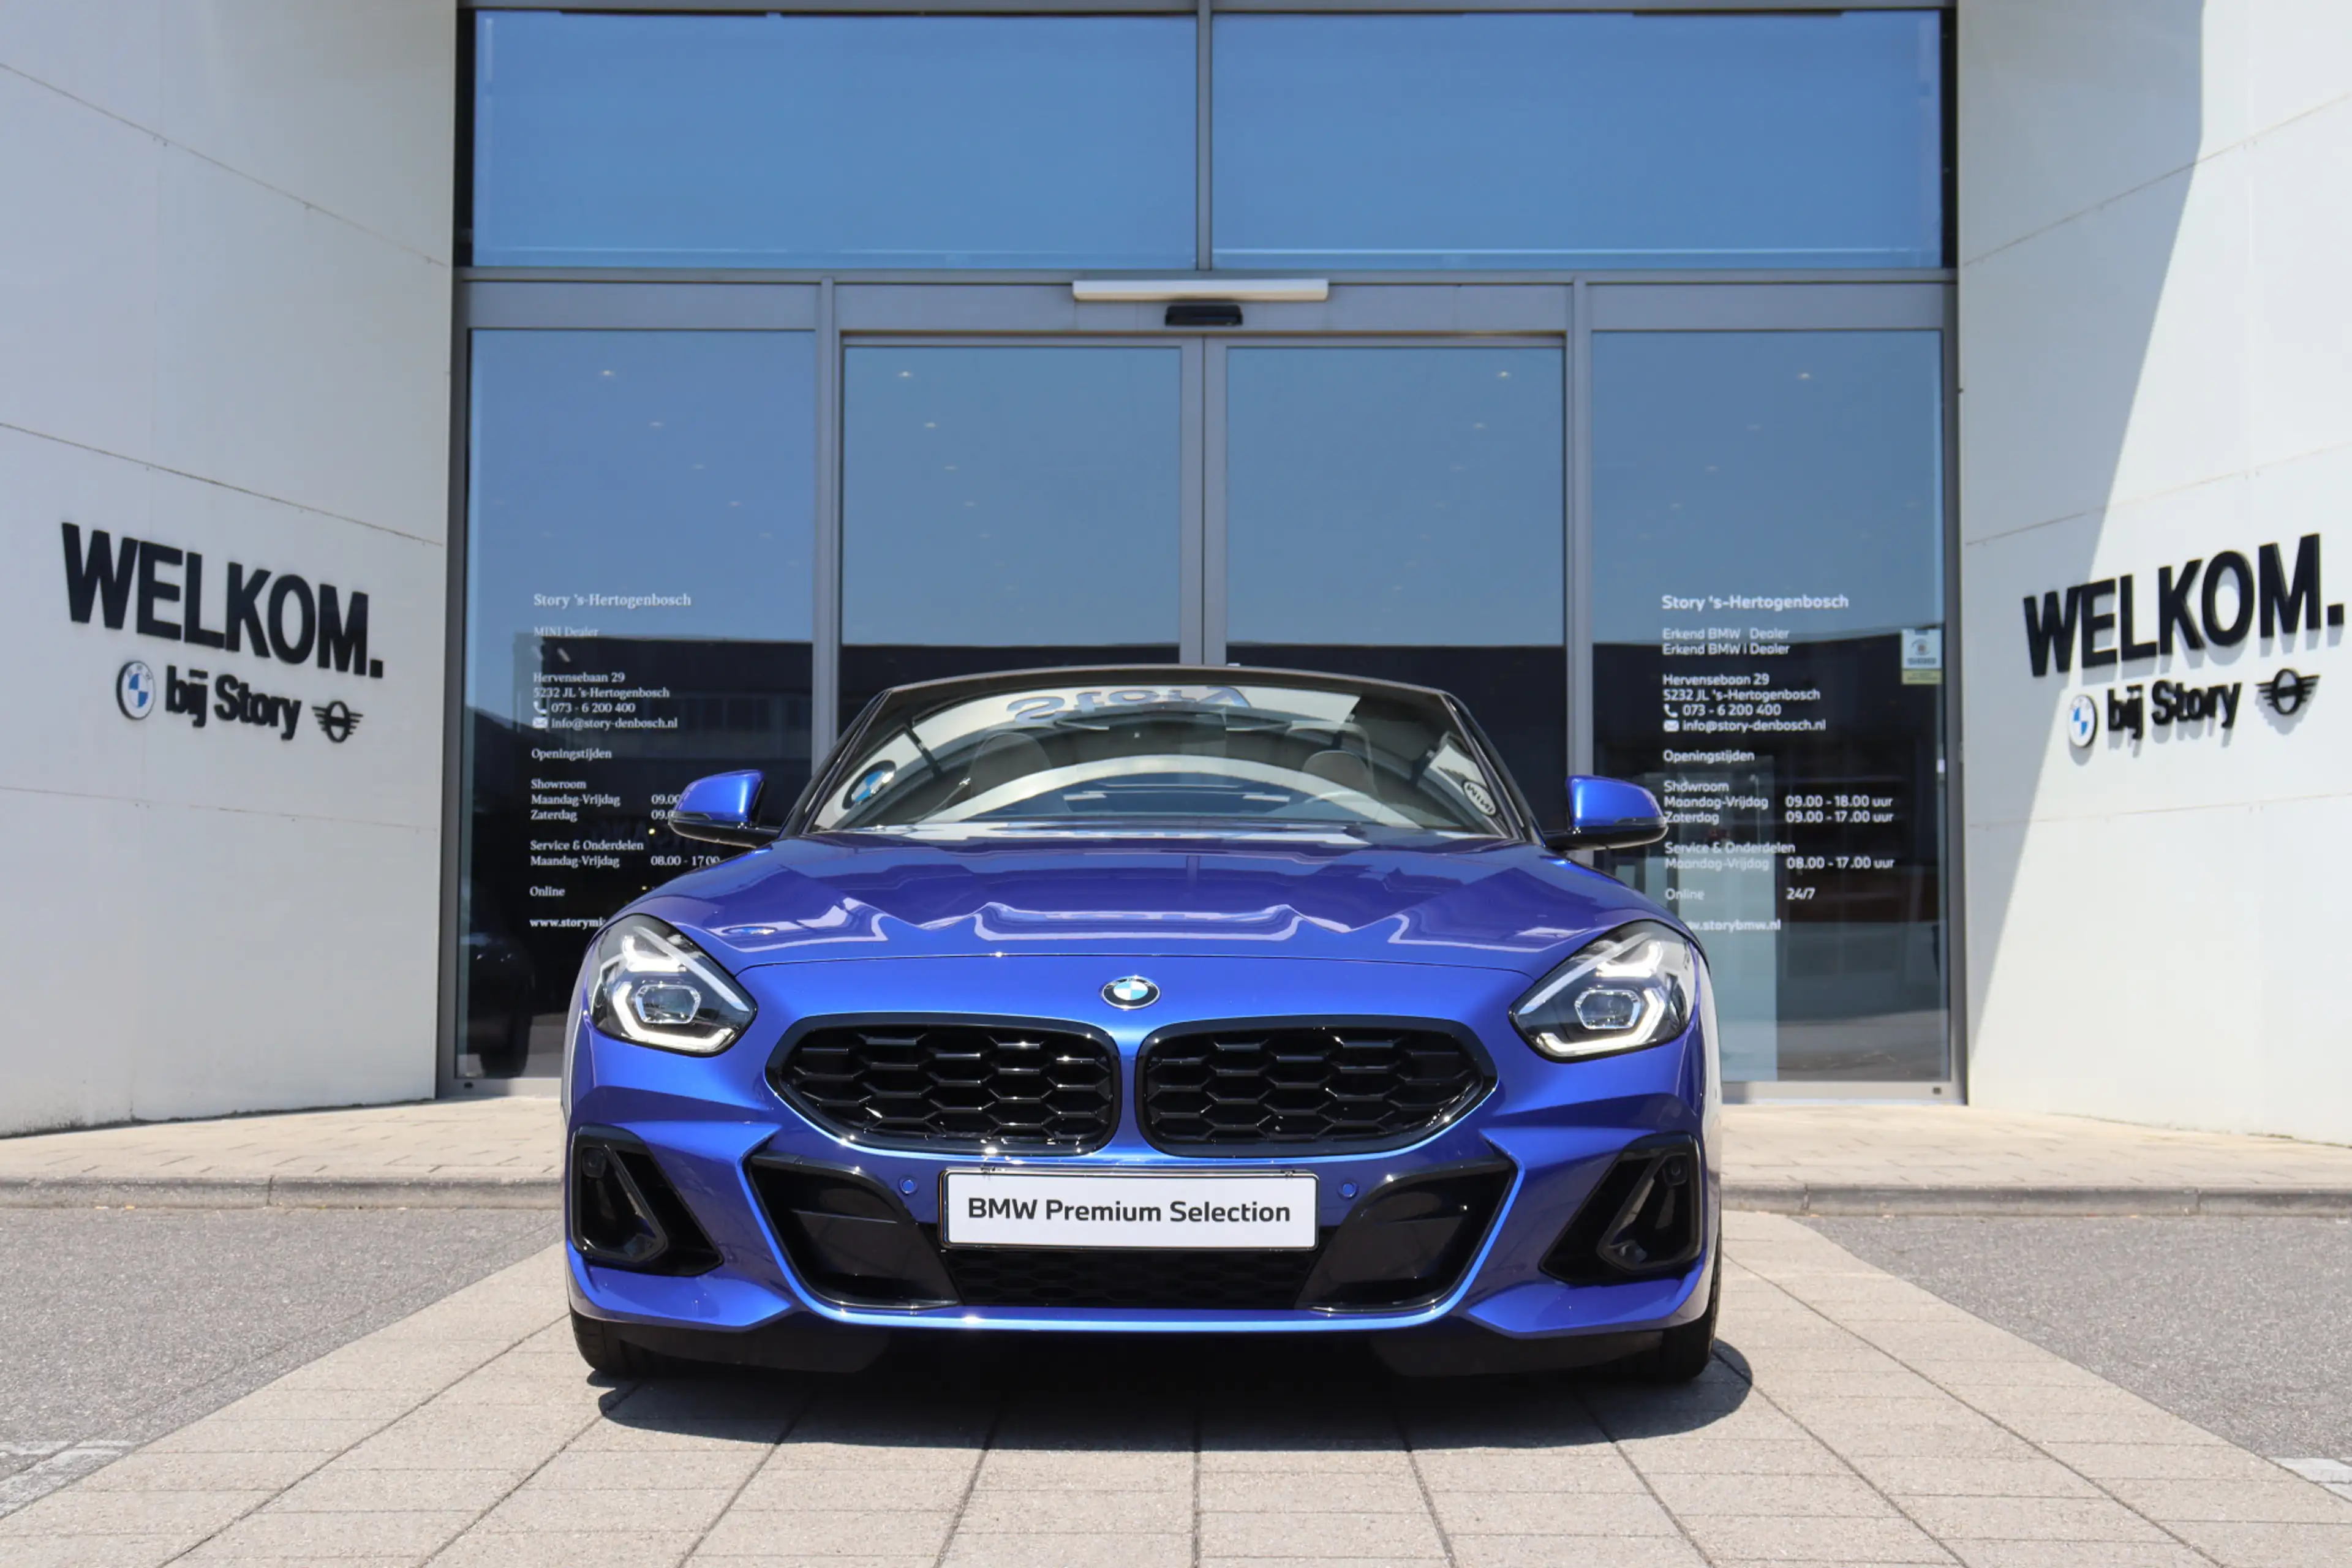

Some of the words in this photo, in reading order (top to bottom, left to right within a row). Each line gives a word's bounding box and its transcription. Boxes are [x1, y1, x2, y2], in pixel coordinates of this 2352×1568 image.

[61, 522, 383, 678] WELKOM.
[533, 594, 570, 609] Story
[574, 594, 692, 609] 's-Hertogenbosch
[1662, 595, 1705, 611] Story
[1709, 595, 1849, 611] 's-Hertogenbosch
[2023, 533, 2344, 677] WELKOM.
[533, 627, 562, 636] MINI
[564, 627, 599, 637] Dealer
[1662, 627, 1705, 639] Erkend
[1708, 628, 1741, 639] BMW
[1749, 627, 1790, 639] Dealer
[1662, 643, 1705, 655] Erkend
[1708, 643, 1740, 655] BMW
[1749, 643, 1790, 655] Dealer
[533, 673, 608, 683] Hervensebaan
[611, 673, 625, 683] 29
[1662, 674, 1751, 686] Hervensebaan
[1754, 673, 1770, 685] 29
[533, 688, 560, 698] 5232
[562, 688, 576, 699] JL
[578, 687, 670, 700] 's-Hertogenbosch
[1663, 689, 1694, 701] 5232
[1696, 690, 1709, 702] JL
[1713, 689, 1820, 703] 's-Hertogenbosch
[214, 674, 301, 741] Story
[551, 703, 572, 713] 073
[582, 703, 589, 713] 6
[592, 703, 612, 713] 200
[615, 703, 636, 713] 400
[1682, 704, 1706, 716] 073
[1717, 704, 1725, 716] 6
[1728, 704, 1753, 716] 200
[1755, 704, 1781, 716] 400
[2152, 680, 2242, 729] Story
[551, 717, 678, 731] info@story-denbosch.nl
[1683, 719, 1826, 733] info@story-denbosch.nl
[532, 748, 612, 761] Openingstijden
[1663, 750, 1755, 763] Openingstijden
[531, 779, 586, 790] Showroom
[1664, 781, 1729, 793] Showroom
[531, 794, 620, 807] Maandag-Vrijdag
[1664, 796, 1768, 810] Maandag-Vrijdag
[1785, 795, 1823, 807] 09.00
[1834, 795, 1869, 807] 18.00
[1872, 798, 1893, 807] uur
[530, 810, 578, 822] Zaterdag
[1664, 810, 1719, 826] Zaterdag
[1785, 811, 1823, 823] 09.00
[1872, 813, 1894, 823] uur
[530, 841, 570, 851] Service
[573, 841, 580, 851] &
[583, 840, 644, 851] Onderdelen
[1664, 842, 1709, 854] Service
[1713, 842, 1722, 853] &
[1725, 842, 1796, 854] Onderdelen
[530, 856, 620, 868] Maandag-Vrijdag
[650, 856, 681, 865] 08.00
[1665, 858, 1770, 871] Maandag-Vrijdag
[1786, 856, 1825, 869] 08.00
[1874, 859, 1895, 869] uur
[530, 887, 565, 897] Online
[1665, 888, 1705, 900] Online
[1787, 888, 1815, 900] 24/7
[529, 917, 605, 930] www.storymi
[968, 1197, 1038, 1219] BMW
[1046, 1199, 1161, 1222] Premium
[1170, 1200, 1291, 1223] Selection
